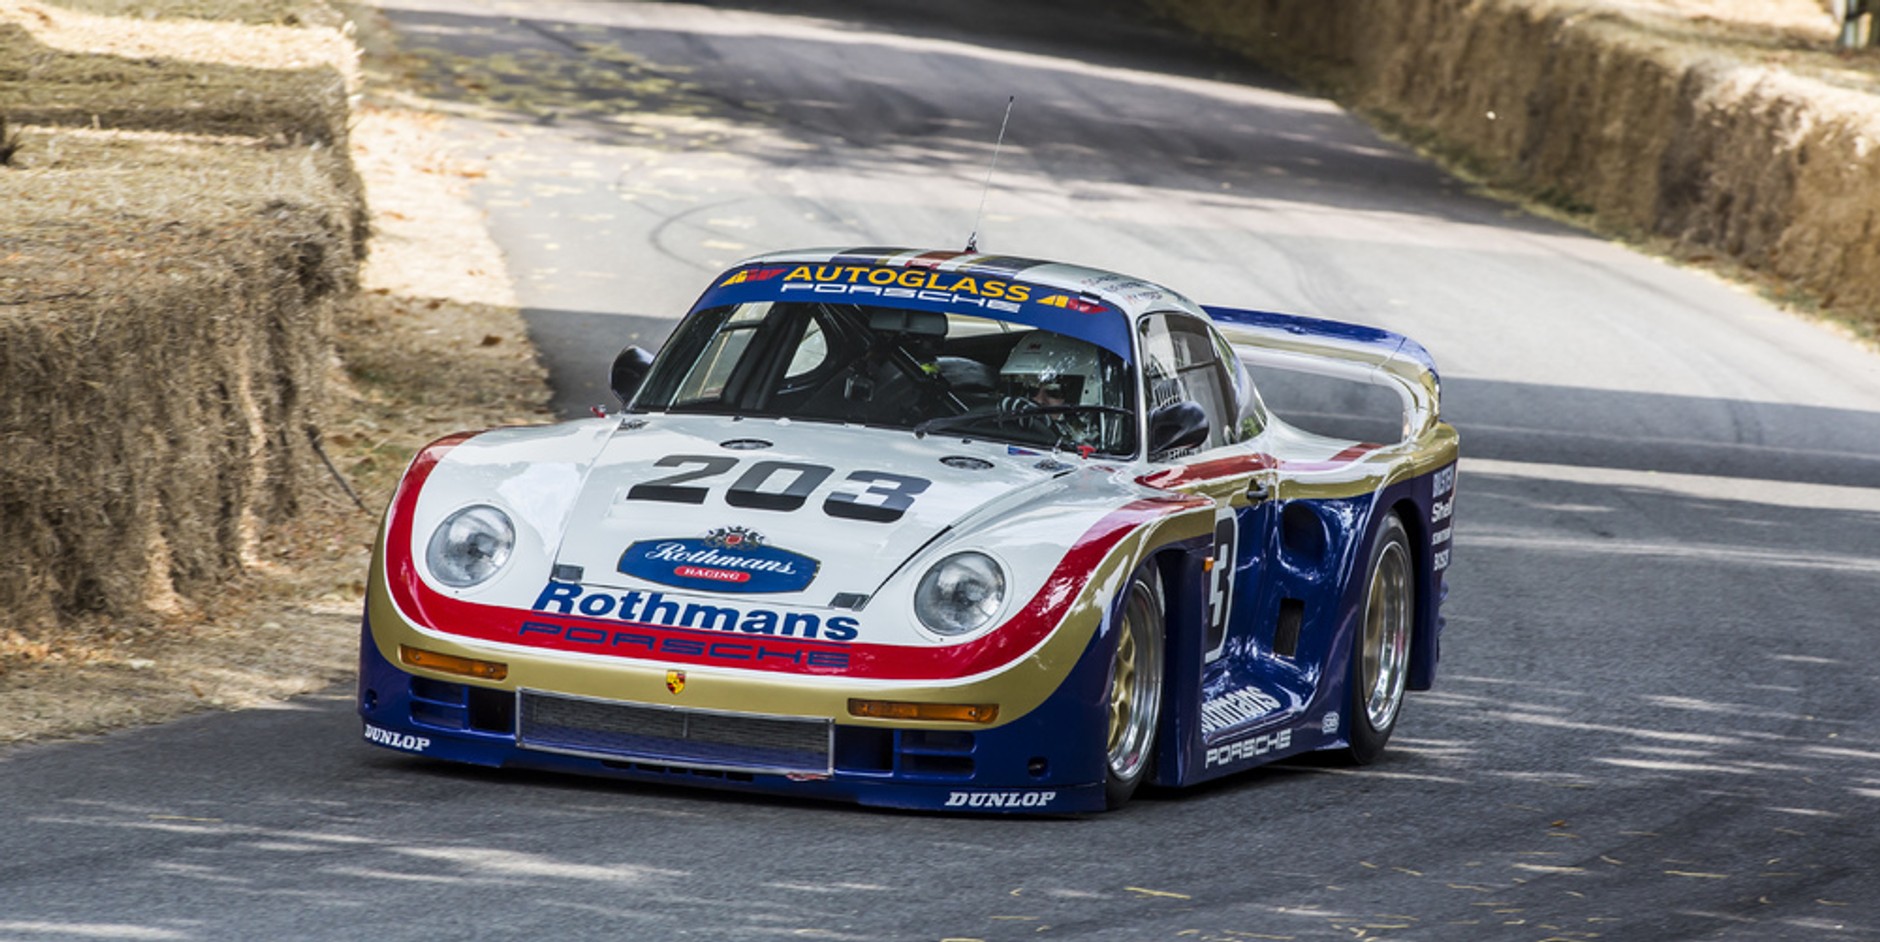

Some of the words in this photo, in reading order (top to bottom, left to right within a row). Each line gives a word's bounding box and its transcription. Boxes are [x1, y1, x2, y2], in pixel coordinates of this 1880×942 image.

[780, 283, 1023, 314] PORSCHE
[781, 265, 1032, 303] AUTOGLASS
[626, 454, 932, 524] 203
[645, 541, 797, 575] Rothmans
[684, 567, 742, 581] RACING
[532, 581, 860, 641] Rothmans
[518, 620, 851, 668] PORSCHE
[364, 723, 431, 752] DUNLOP
[1205, 728, 1292, 769] PORSCHE
[944, 791, 1057, 808] DUNLOP
